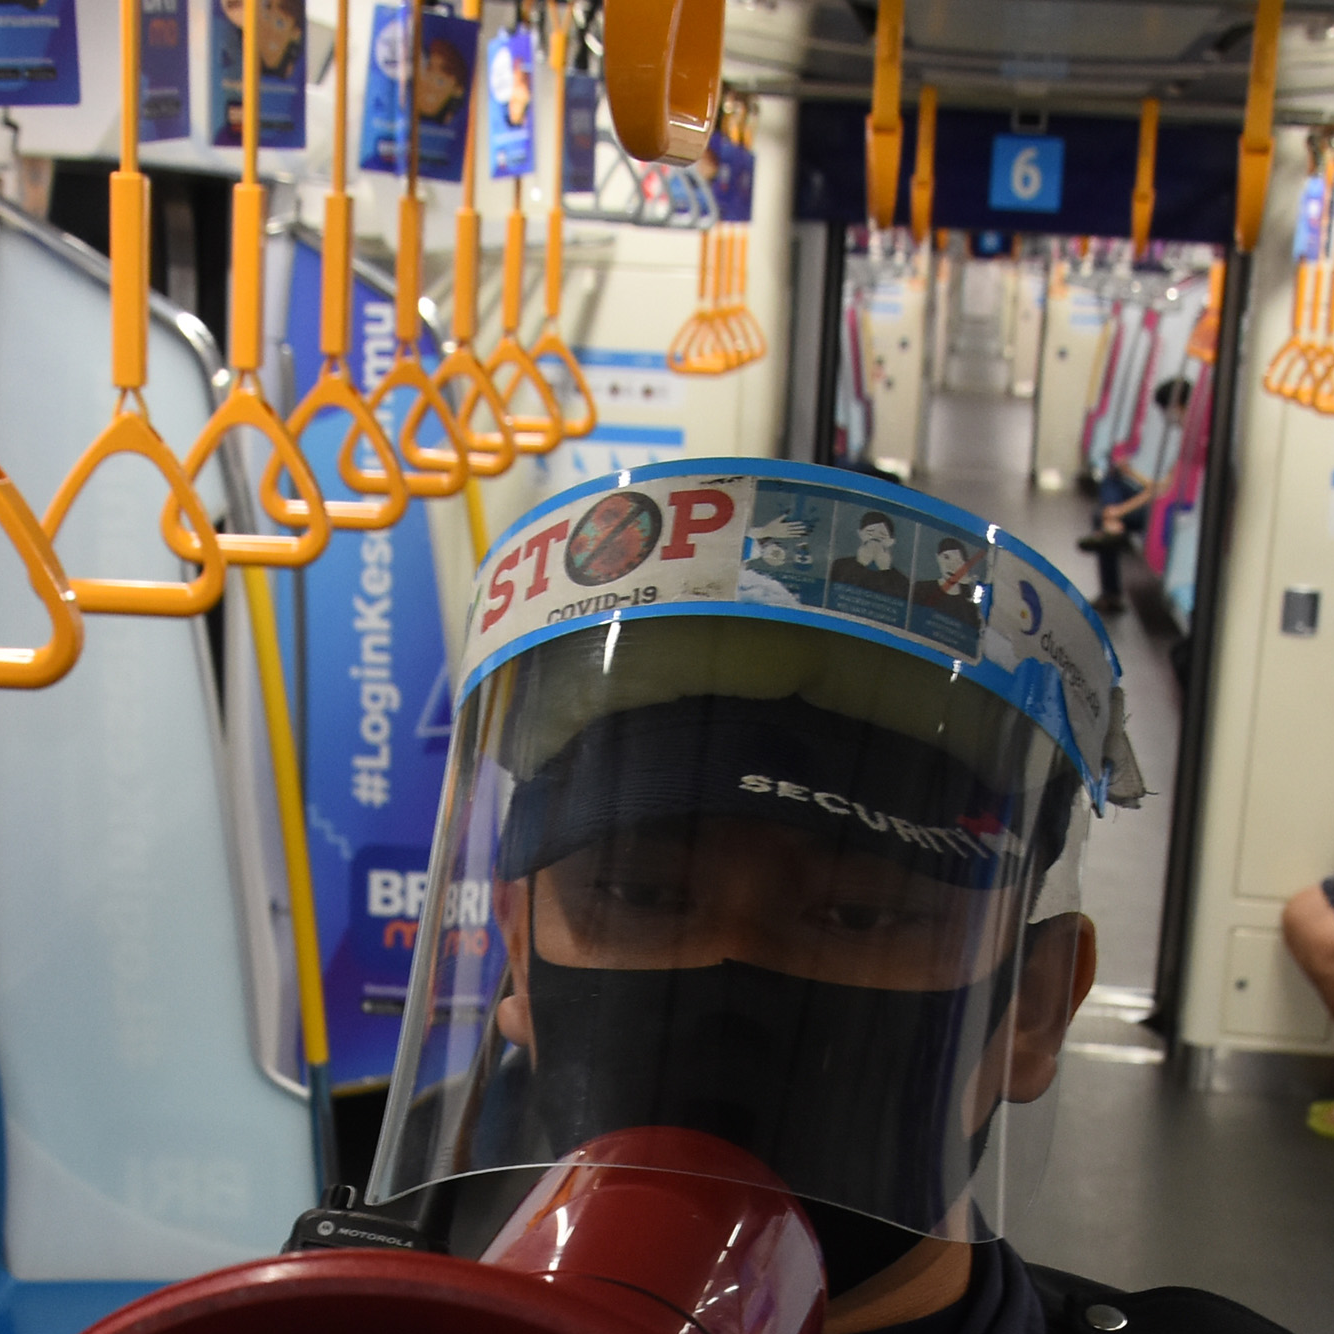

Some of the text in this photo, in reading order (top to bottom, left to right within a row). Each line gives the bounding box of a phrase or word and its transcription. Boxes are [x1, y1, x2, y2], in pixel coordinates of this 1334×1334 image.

[1010, 152, 1042, 199] 6
[547, 586, 658, 624] COVID-19
[337, 1227, 414, 1248] MOTOROLA
